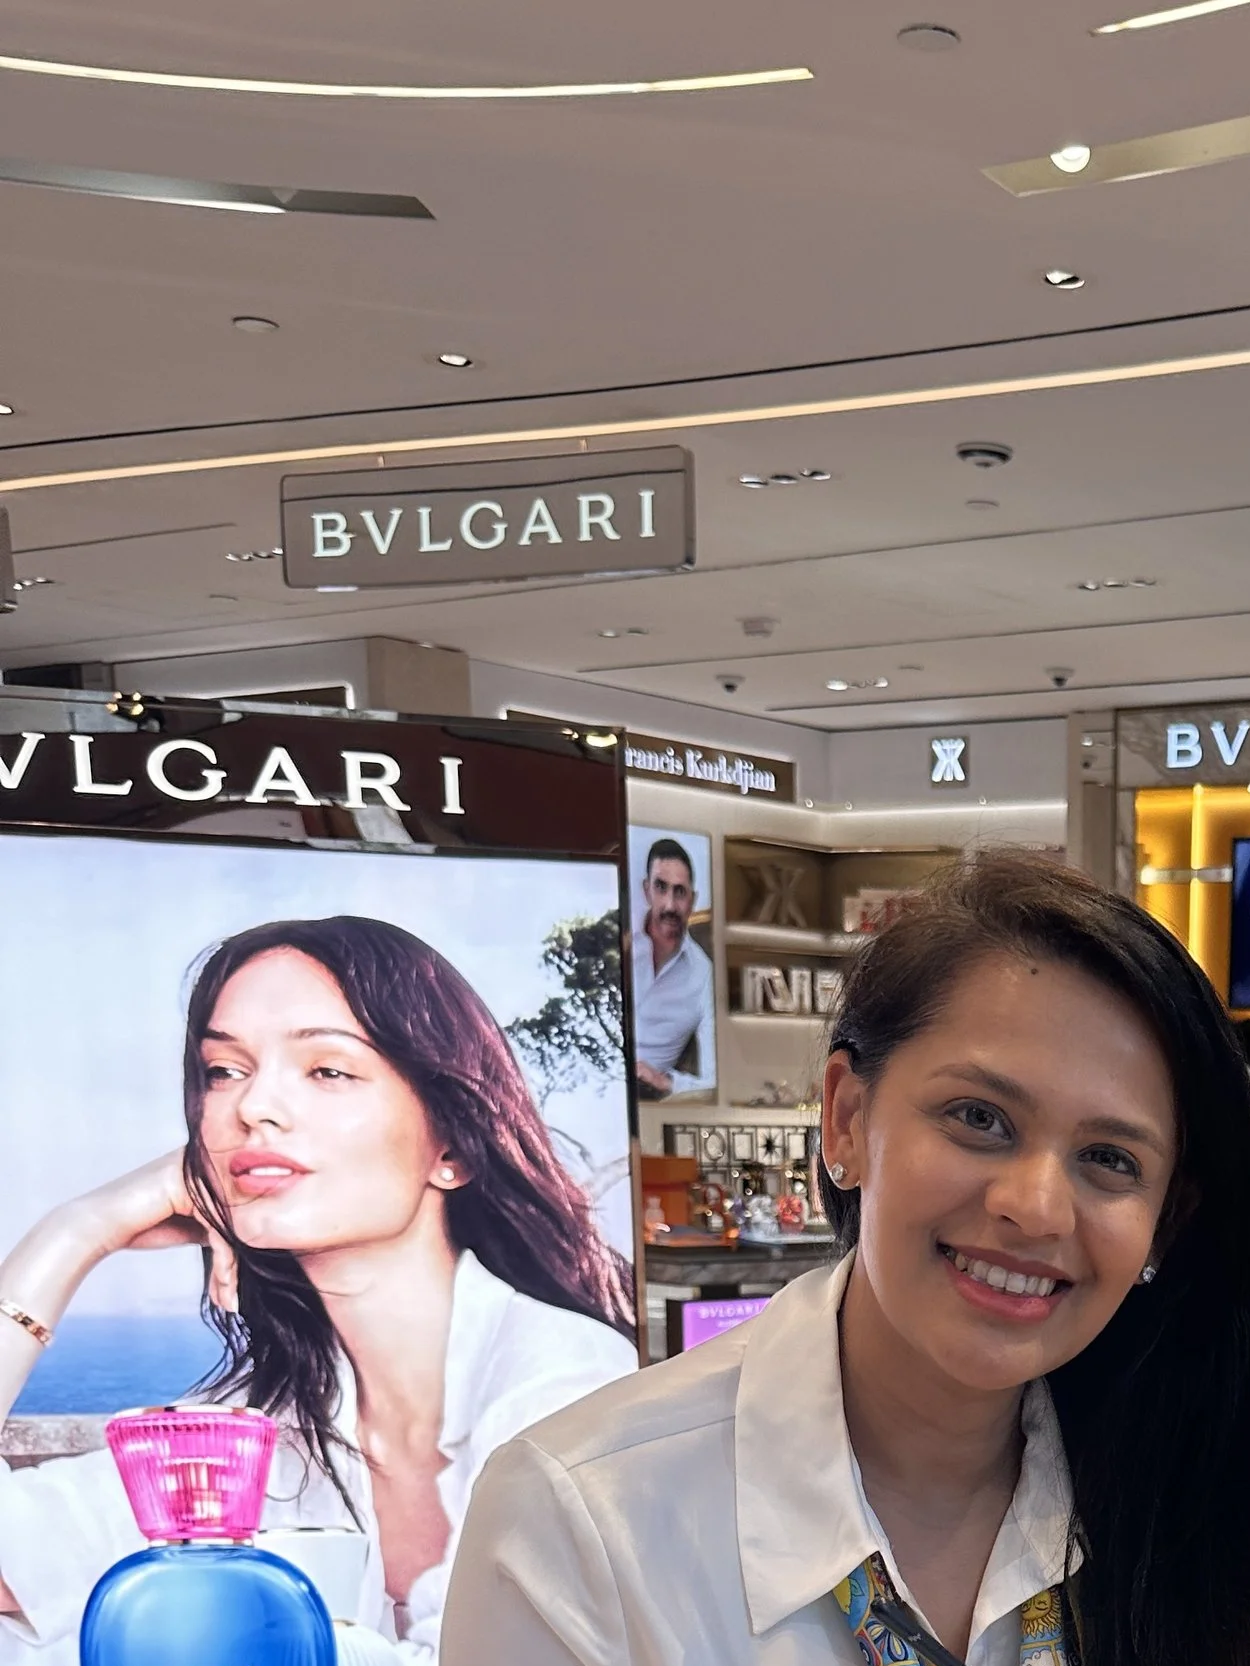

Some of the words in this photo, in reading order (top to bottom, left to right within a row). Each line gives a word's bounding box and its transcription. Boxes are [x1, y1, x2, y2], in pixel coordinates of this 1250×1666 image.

[311, 489, 655, 557] BVLGARI
[625, 746, 684, 776] rancis
[685, 748, 776, 795] Kurkdjian
